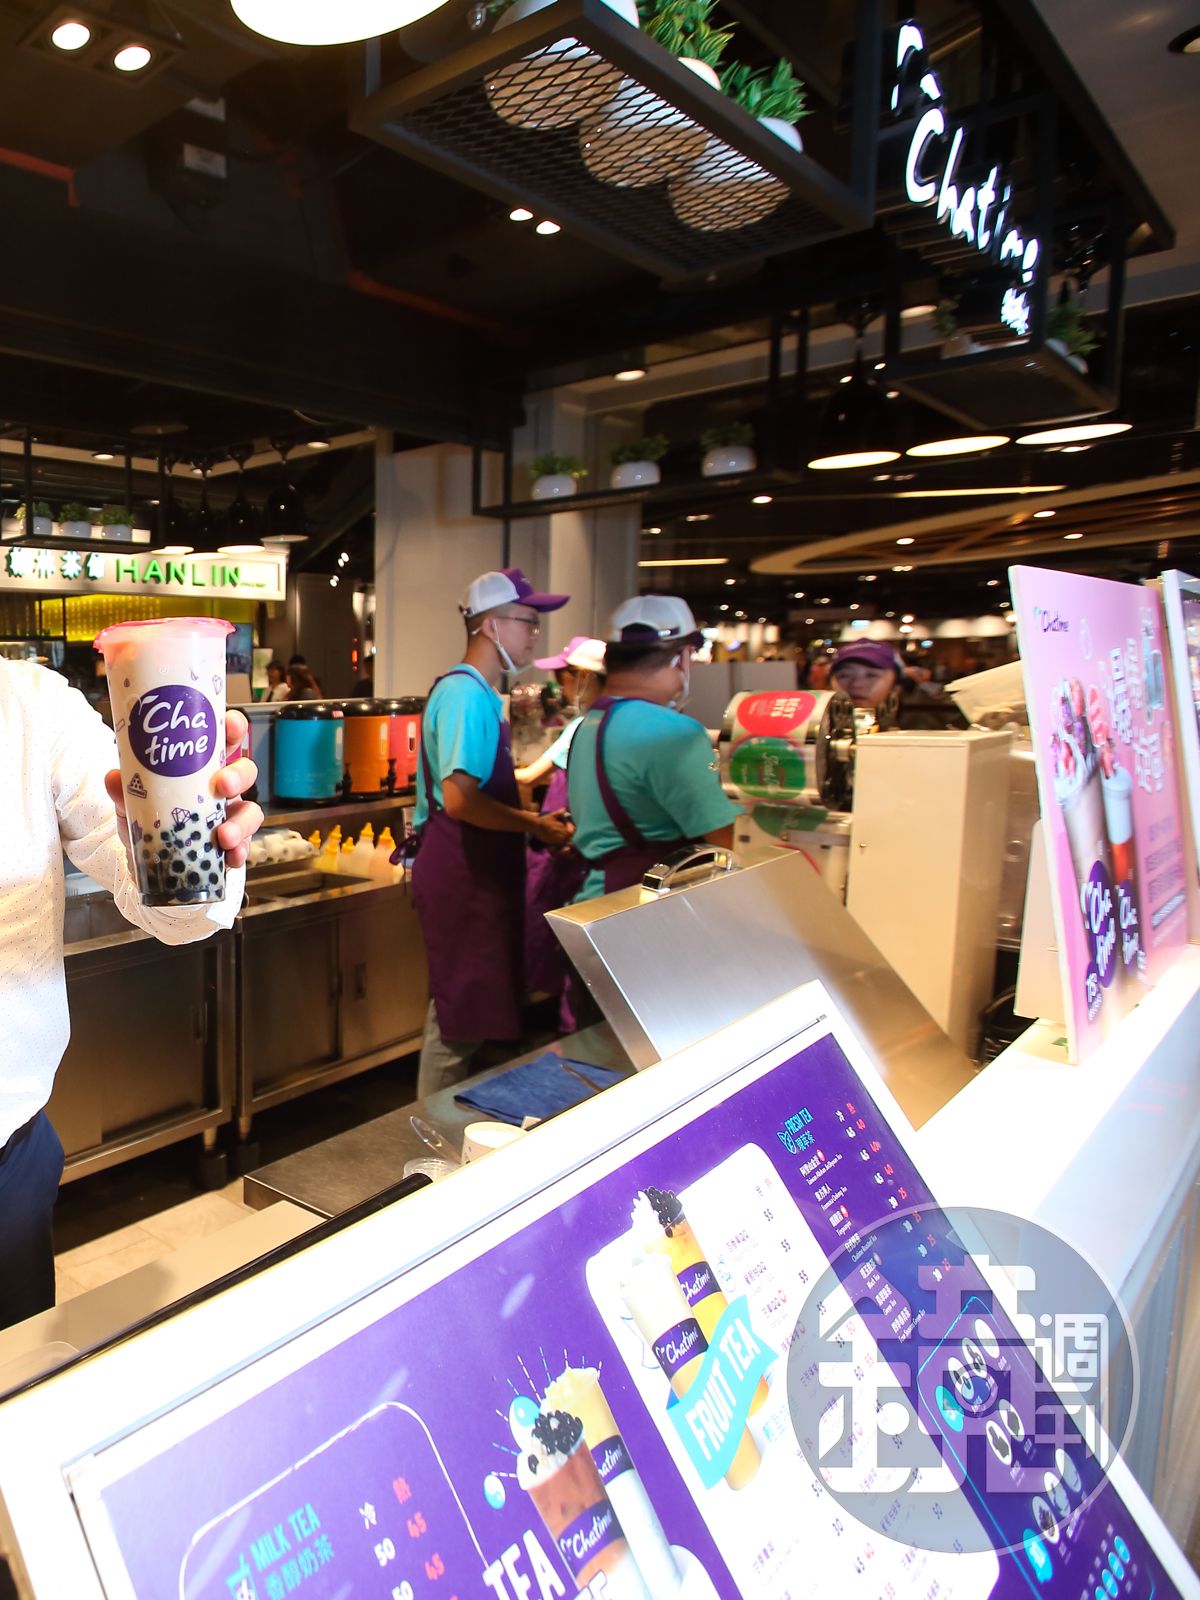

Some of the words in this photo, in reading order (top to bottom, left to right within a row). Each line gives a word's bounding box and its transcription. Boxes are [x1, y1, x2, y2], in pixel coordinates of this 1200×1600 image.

[116, 559, 240, 587] HANLIN
[143, 701, 208, 734] Cha
[145, 735, 208, 766] time
[784, 1113, 805, 1135] FRESH
[799, 1107, 814, 1125] TEA
[763, 1208, 774, 1222] 55
[781, 1238, 791, 1253] 55
[798, 1269, 809, 1284] 55
[685, 1357, 736, 1461] FRUIT
[720, 1318, 761, 1381] TEA
[250, 1523, 292, 1571] MILK
[288, 1503, 321, 1542] TEA
[375, 1537, 395, 1567] 50
[407, 1511, 427, 1538] 45
[425, 1552, 445, 1580] 45
[482, 1529, 566, 1600] TEA
